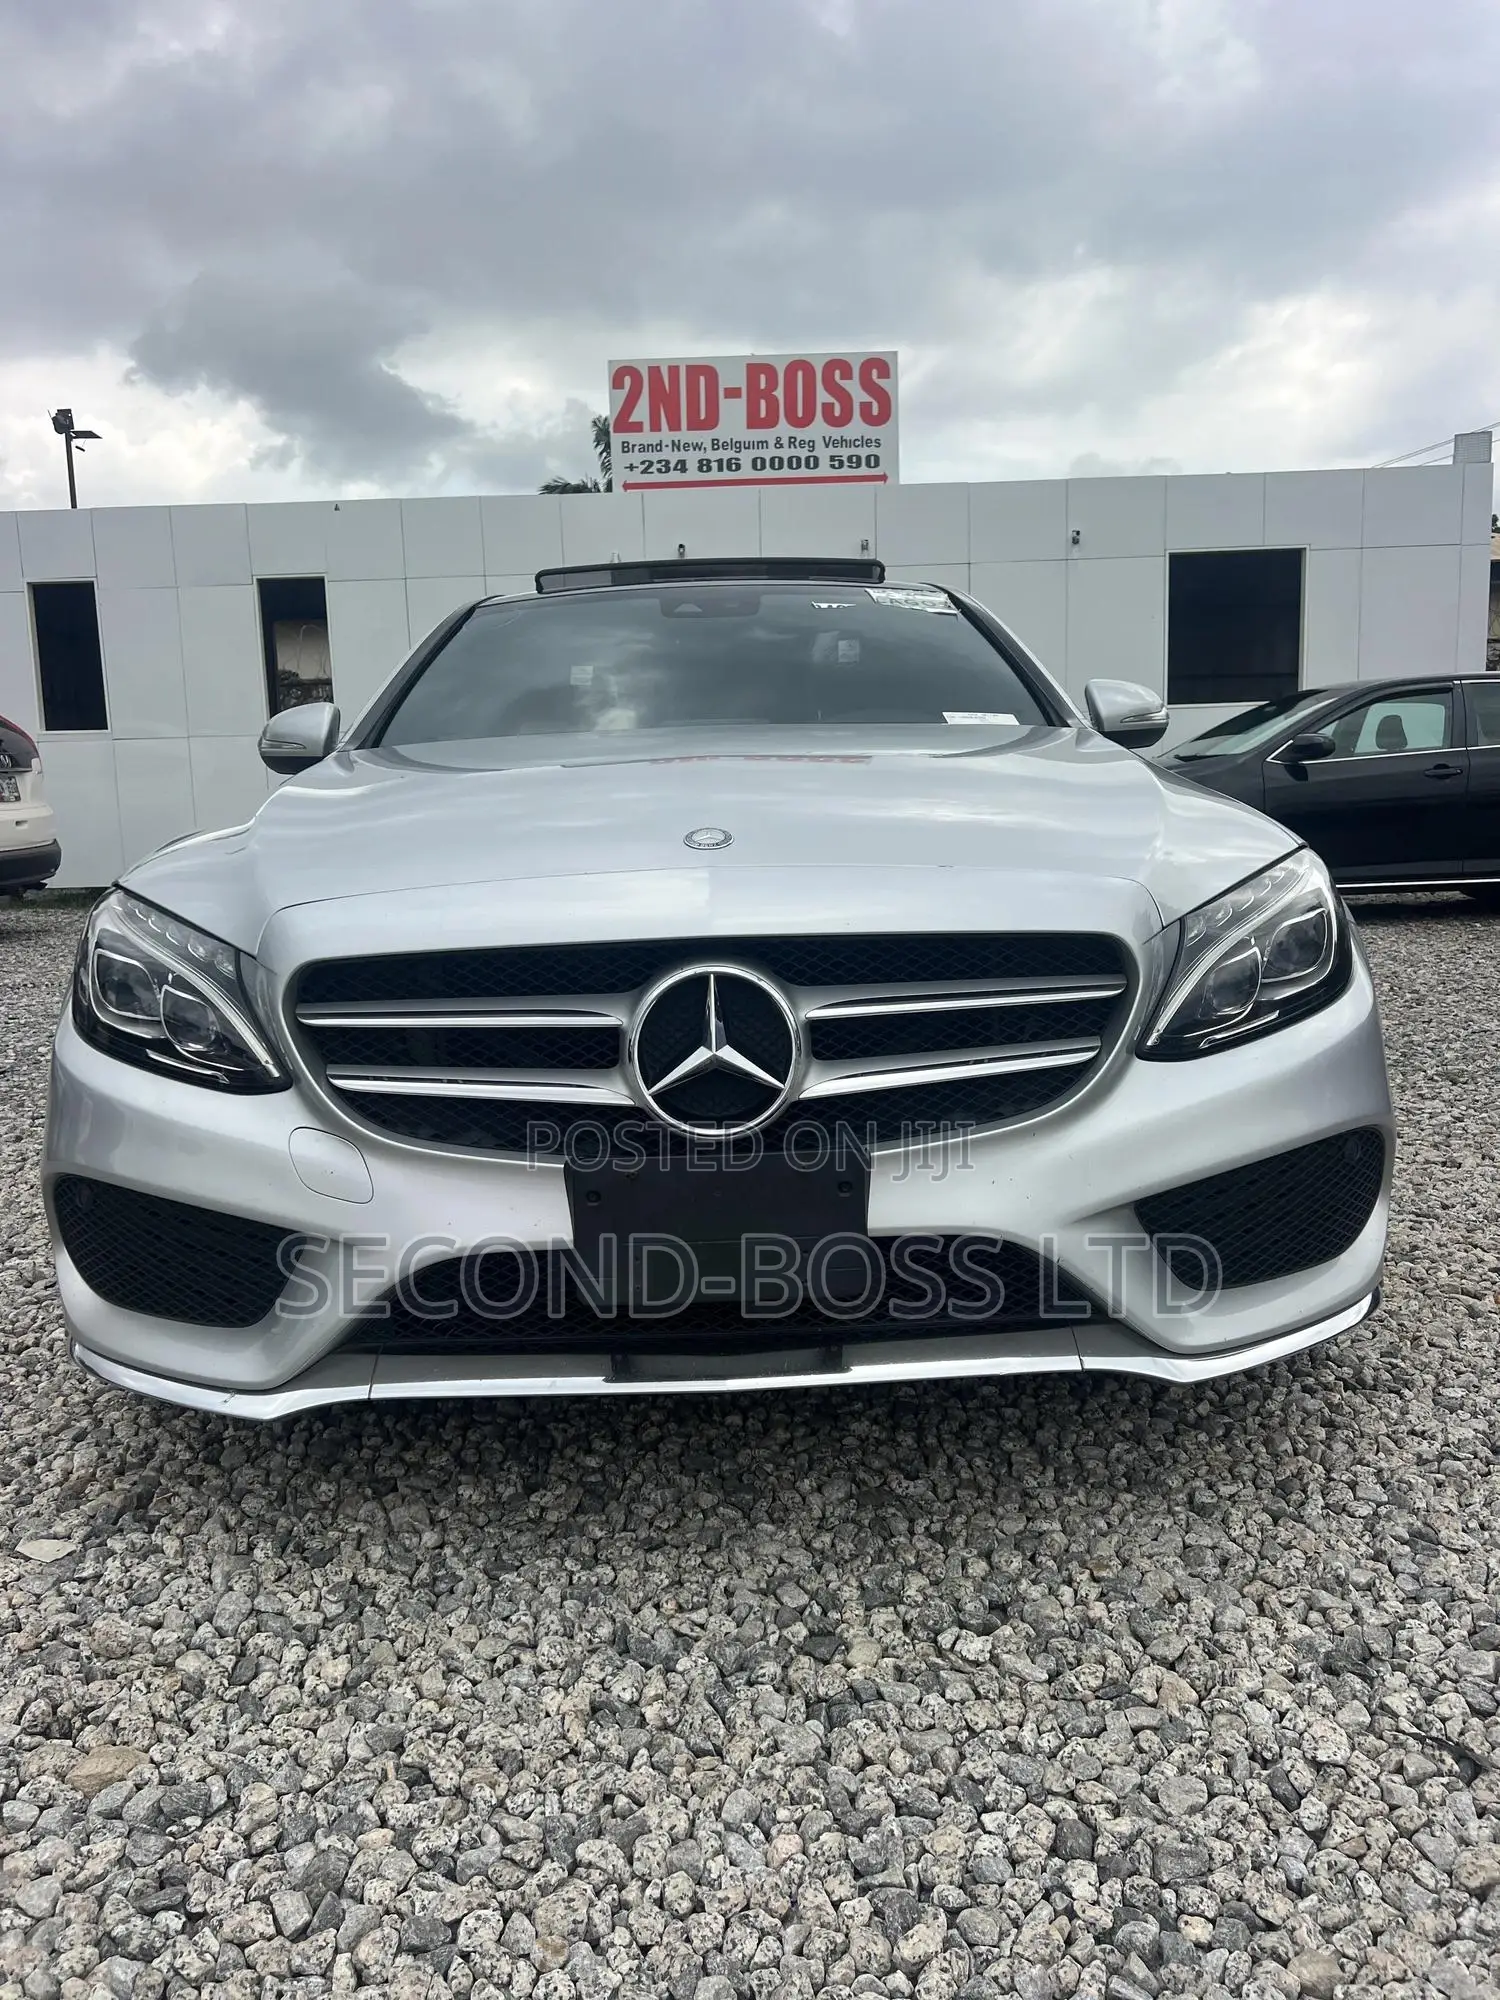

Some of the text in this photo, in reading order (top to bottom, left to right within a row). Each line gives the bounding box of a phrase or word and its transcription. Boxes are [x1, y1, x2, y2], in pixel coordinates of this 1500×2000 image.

[612, 357, 892, 433] 2ND-BOSS
[621, 439, 707, 454] Brand-New,
[774, 437, 784, 449] &
[788, 435, 815, 452] Reg
[822, 436, 881, 449] Vehicles
[624, 454, 881, 475] +234 816 0000 590
